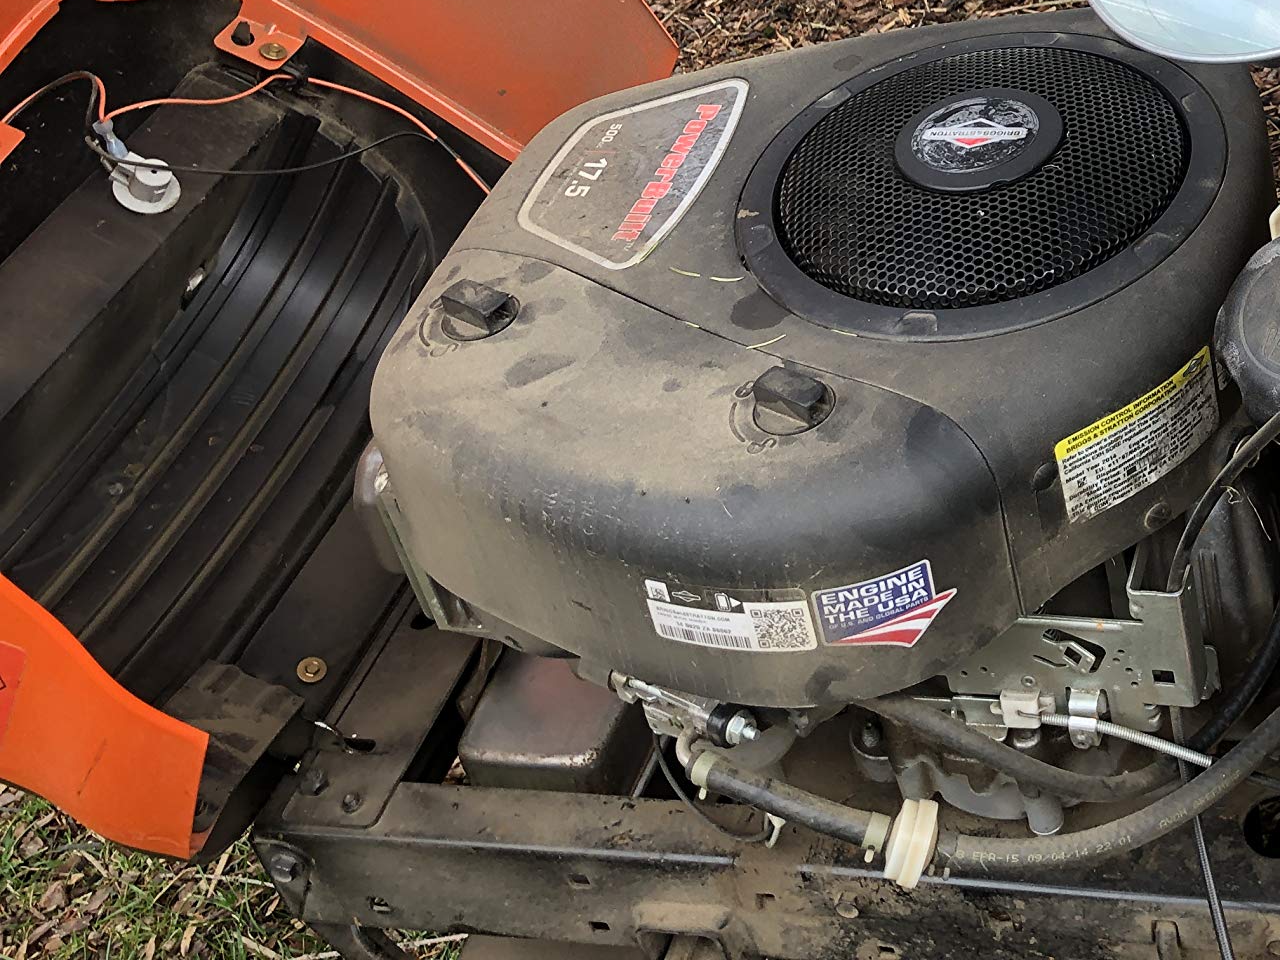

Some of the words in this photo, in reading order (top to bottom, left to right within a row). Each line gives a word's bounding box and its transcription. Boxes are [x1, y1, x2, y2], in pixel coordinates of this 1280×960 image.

[565, 158, 608, 198] 17.5
[611, 104, 722, 241] PowerBuilt
[1066, 438, 1092, 454] BRIGGS
[1100, 412, 1134, 436] STRATTON
[1135, 384, 1177, 416] CORPORATION
[1067, 423, 1101, 444] EMISSION
[1100, 407, 1132, 427] CONTROL
[1133, 379, 1174, 410] INFORMATION
[821, 566, 922, 605] ENGINE
[824, 590, 894, 616] MADE
[901, 578, 925, 595] IN
[824, 607, 870, 624] THE
[877, 588, 928, 613] USA
[857, 616, 874, 625] AND
[876, 608, 904, 620] GLOBAL
[906, 597, 928, 609] PARTS
